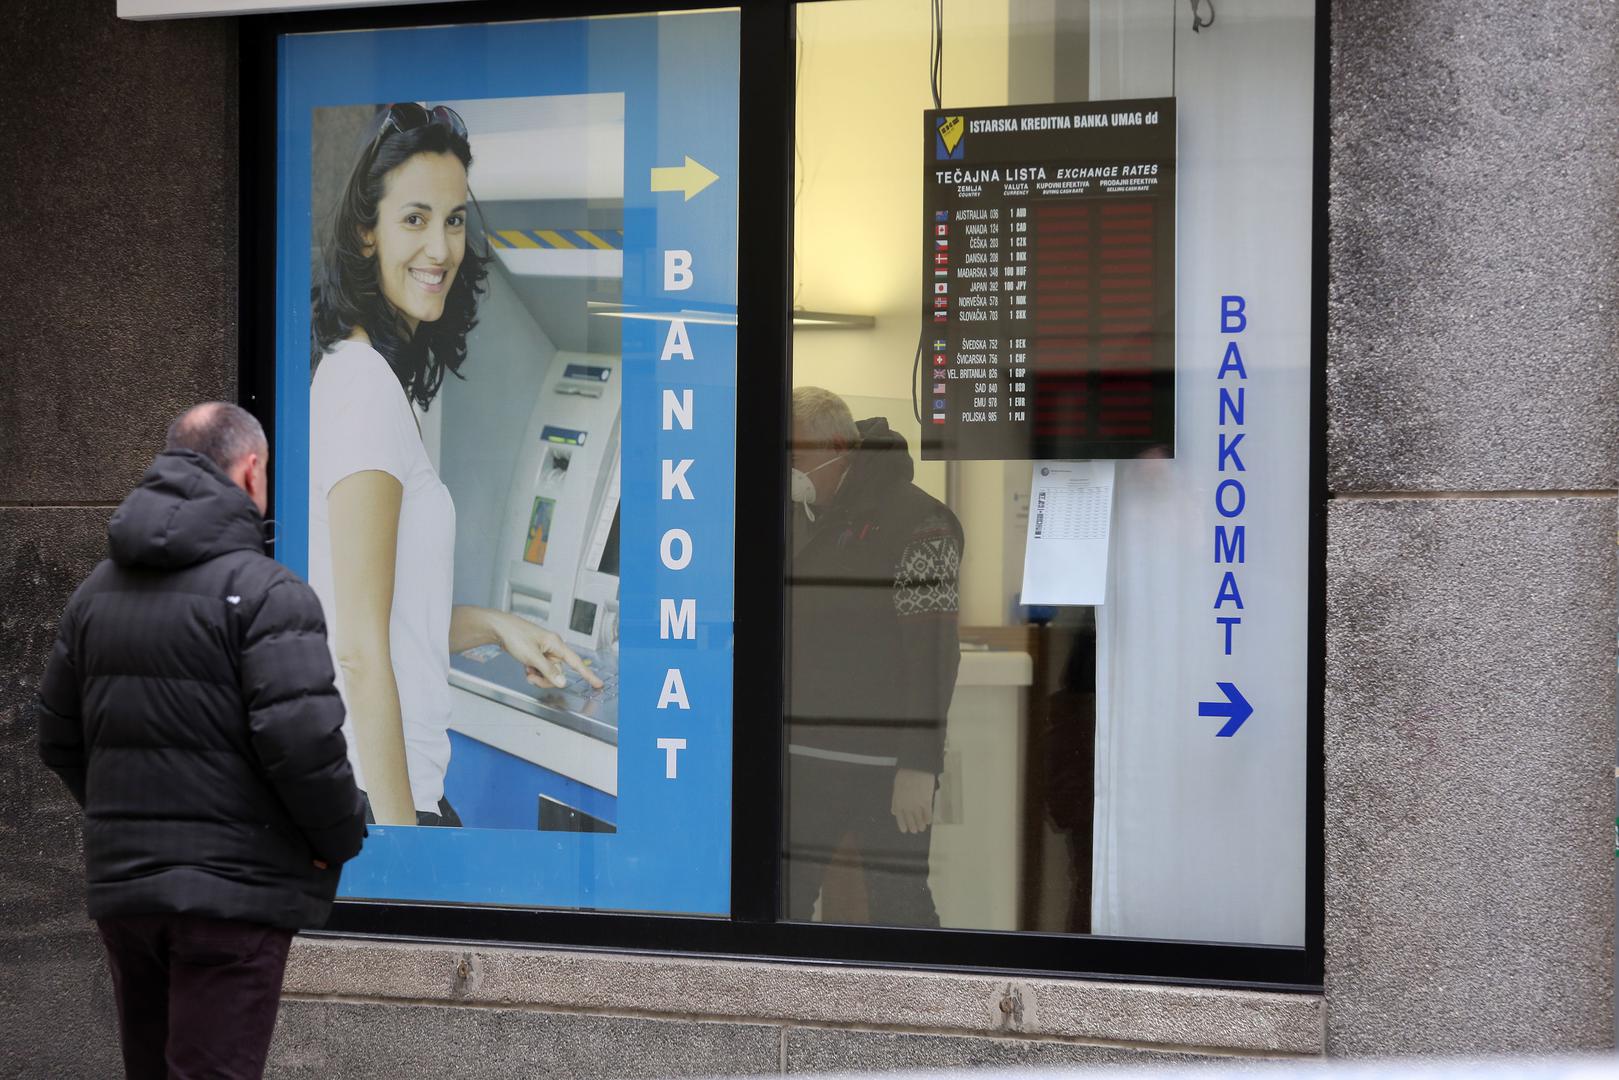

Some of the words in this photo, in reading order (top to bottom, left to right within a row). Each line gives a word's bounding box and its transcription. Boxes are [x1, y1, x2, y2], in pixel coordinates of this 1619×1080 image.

[970, 118, 1018, 133] ISTARSKA
[1021, 116, 1070, 130] KREDITNA
[1074, 114, 1108, 128] BANKA
[1111, 112, 1142, 126] UMAG
[1145, 111, 1158, 124] dd
[936, 168, 1000, 184] TEČAJNA
[1006, 167, 1046, 181] LISTA
[1057, 166, 1118, 179] EXCHANGE
[1122, 164, 1158, 176] RATES
[966, 224, 987, 234] KANADA
[990, 224, 998, 233] 124
[1016, 223, 1026, 232] CAD
[970, 236, 987, 248] ČEŠKA
[990, 238, 998, 248] 203
[1016, 237, 1026, 246] CZK
[966, 253, 987, 263] DANSKA
[990, 267, 998, 277] 348
[1004, 267, 1013, 276] 100
[970, 282, 987, 292] JAPAN
[989, 282, 998, 291] 392
[1004, 281, 1013, 291] 100
[1016, 281, 1026, 290] JPY
[959, 295, 987, 307] NORVEŠKA
[989, 296, 998, 306] 578
[959, 309, 987, 321] SLOVAČKA
[989, 311, 998, 320] 703
[1016, 310, 1026, 319] SKK
[962, 338, 987, 350] ŠVEDSKA
[989, 339, 997, 349] 752
[957, 353, 986, 364] ŠVICARSKA
[989, 354, 997, 364] 756
[947, 369, 958, 379] VEL.
[989, 369, 997, 378] 826
[975, 383, 986, 393] SAD
[974, 398, 986, 407] EMU
[988, 398, 997, 407] 978
[1015, 398, 1025, 406] EUR
[962, 412, 986, 422] POLJSKA
[1015, 412, 1025, 421] PLN
[1213, 295, 1248, 656] BANKOMAT
[657, 249, 696, 779] BANKOMAT
